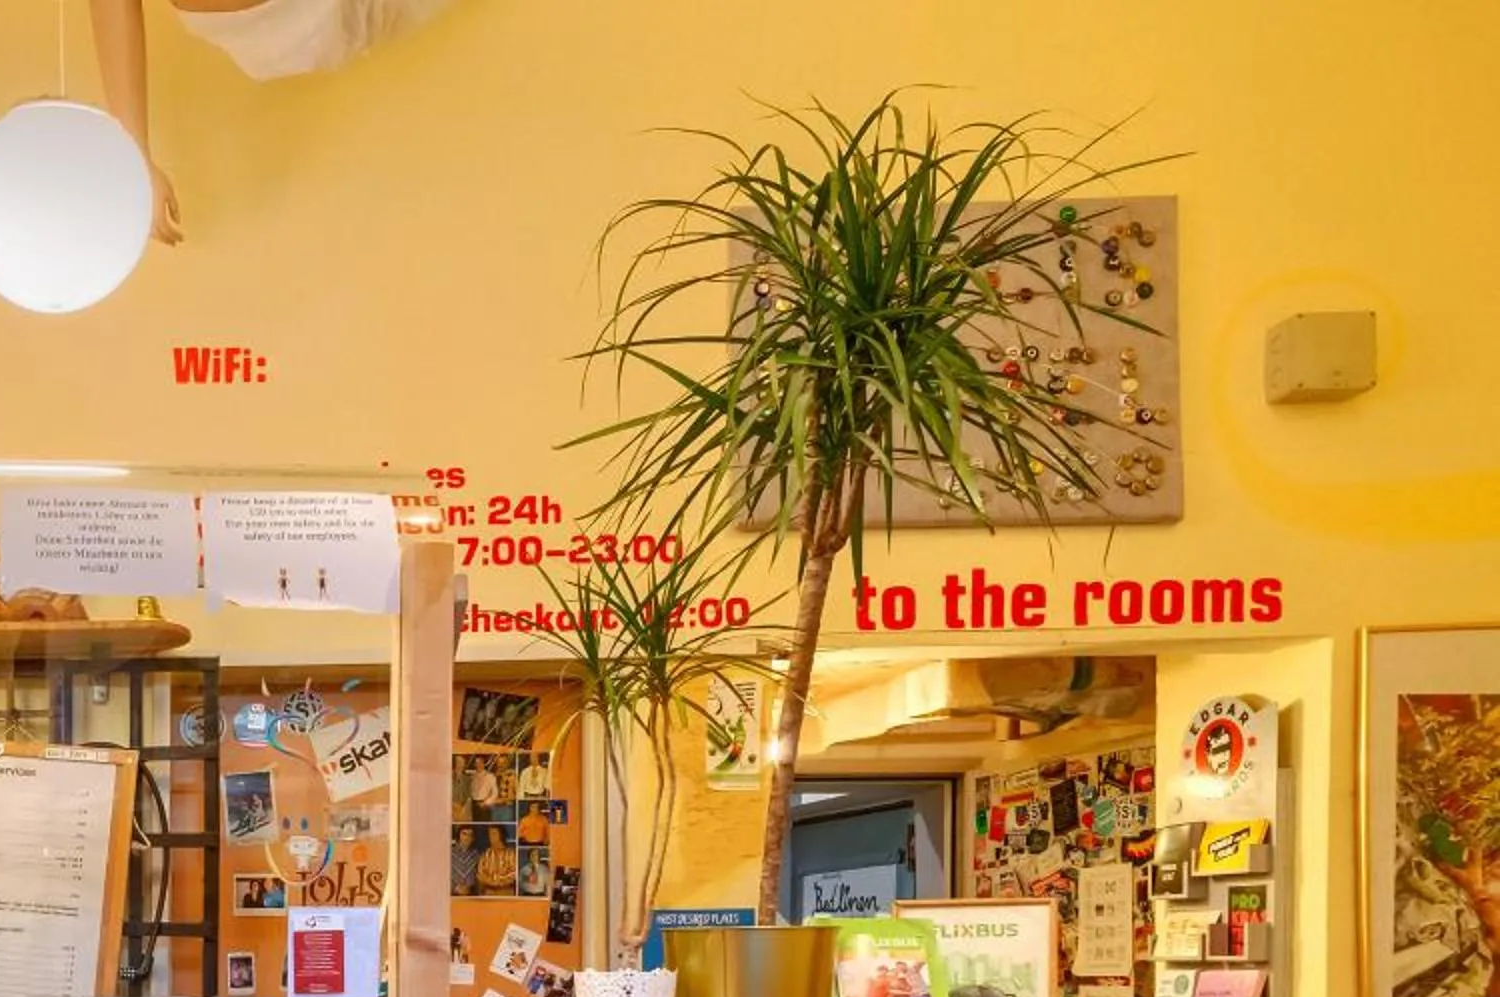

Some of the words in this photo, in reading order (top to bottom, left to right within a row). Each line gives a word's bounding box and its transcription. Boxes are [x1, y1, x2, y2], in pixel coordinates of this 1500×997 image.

[173, 347, 266, 384] WiFi:
[488, 495, 562, 525] 24h
[852, 575, 916, 631] to
[942, 567, 1047, 628] the
[1074, 577, 1283, 625] rooms
